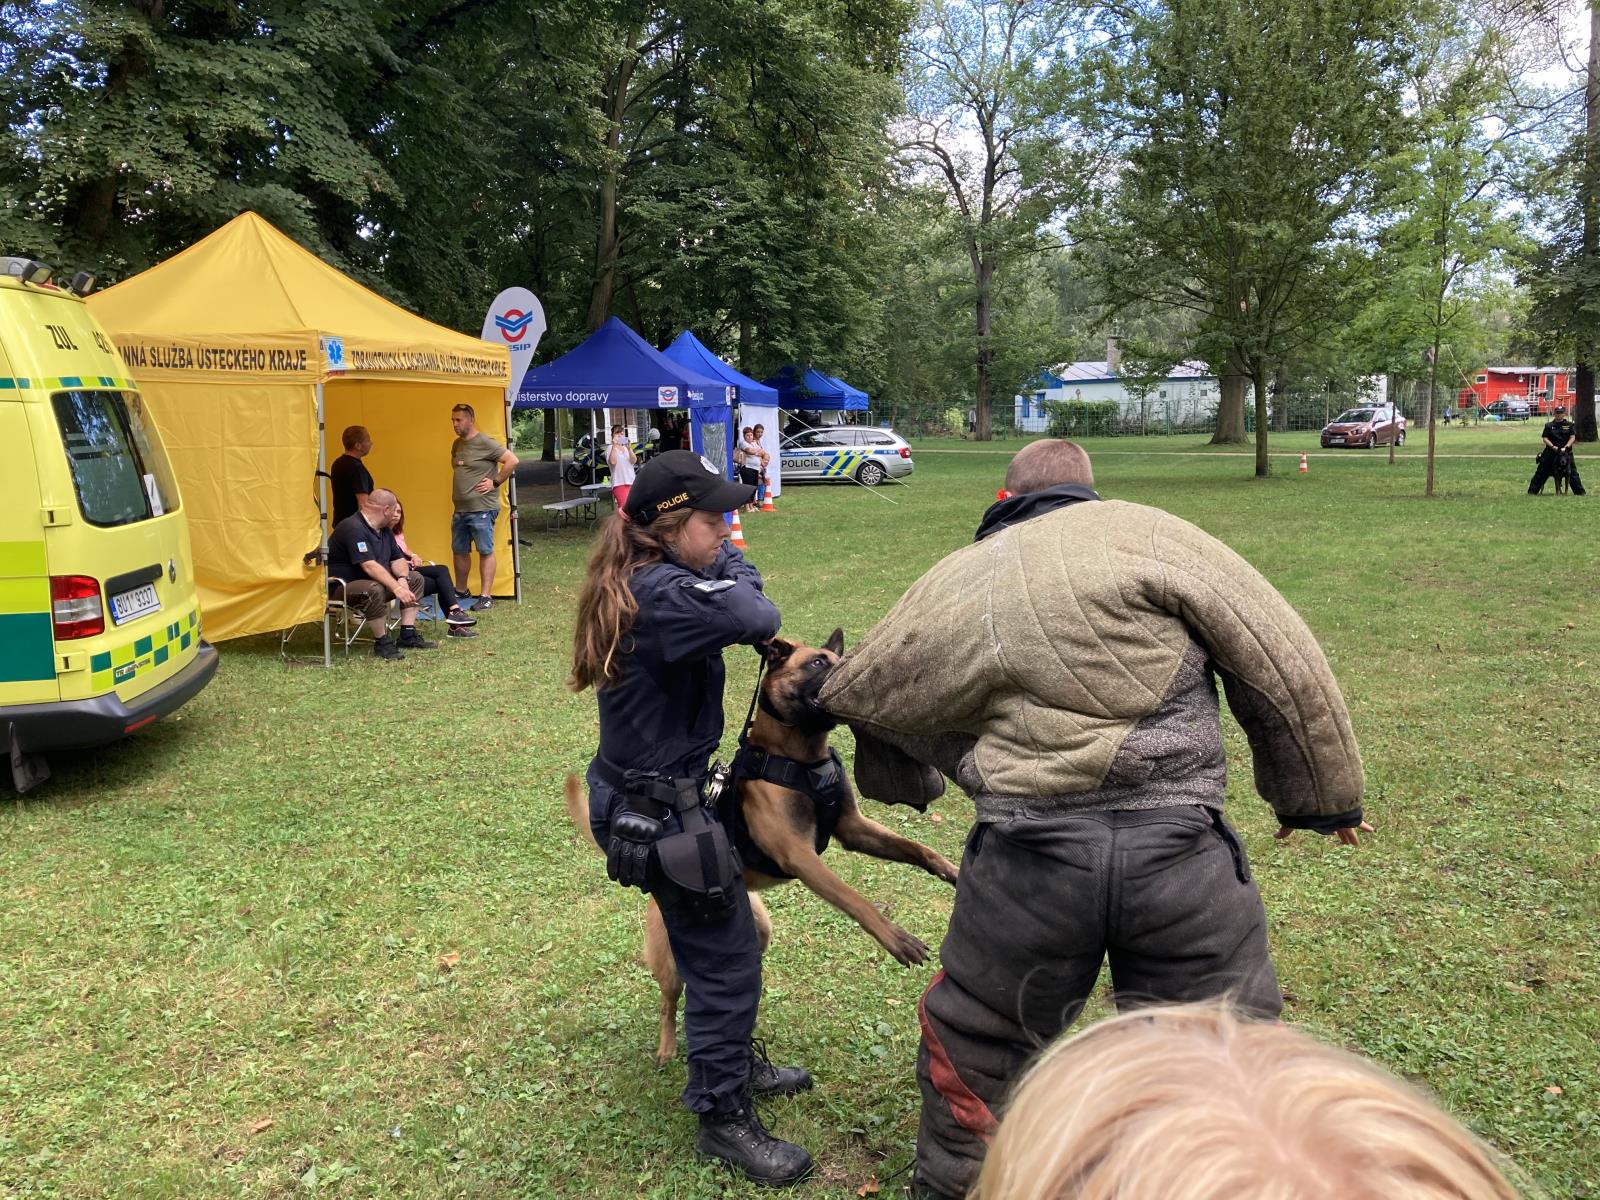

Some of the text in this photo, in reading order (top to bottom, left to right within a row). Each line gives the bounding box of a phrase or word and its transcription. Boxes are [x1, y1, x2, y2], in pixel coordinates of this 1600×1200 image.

[44, 324, 79, 350] ZUL
[508, 343, 531, 351] ESIP
[150, 343, 194, 369] SLUŽBA
[197, 343, 265, 370] ÚSTECKÉHO
[269, 349, 307, 371] KRAJE
[565, 391, 609, 403] dopravy
[781, 459, 820, 468] POLICIE
[656, 492, 689, 511] POLICIE
